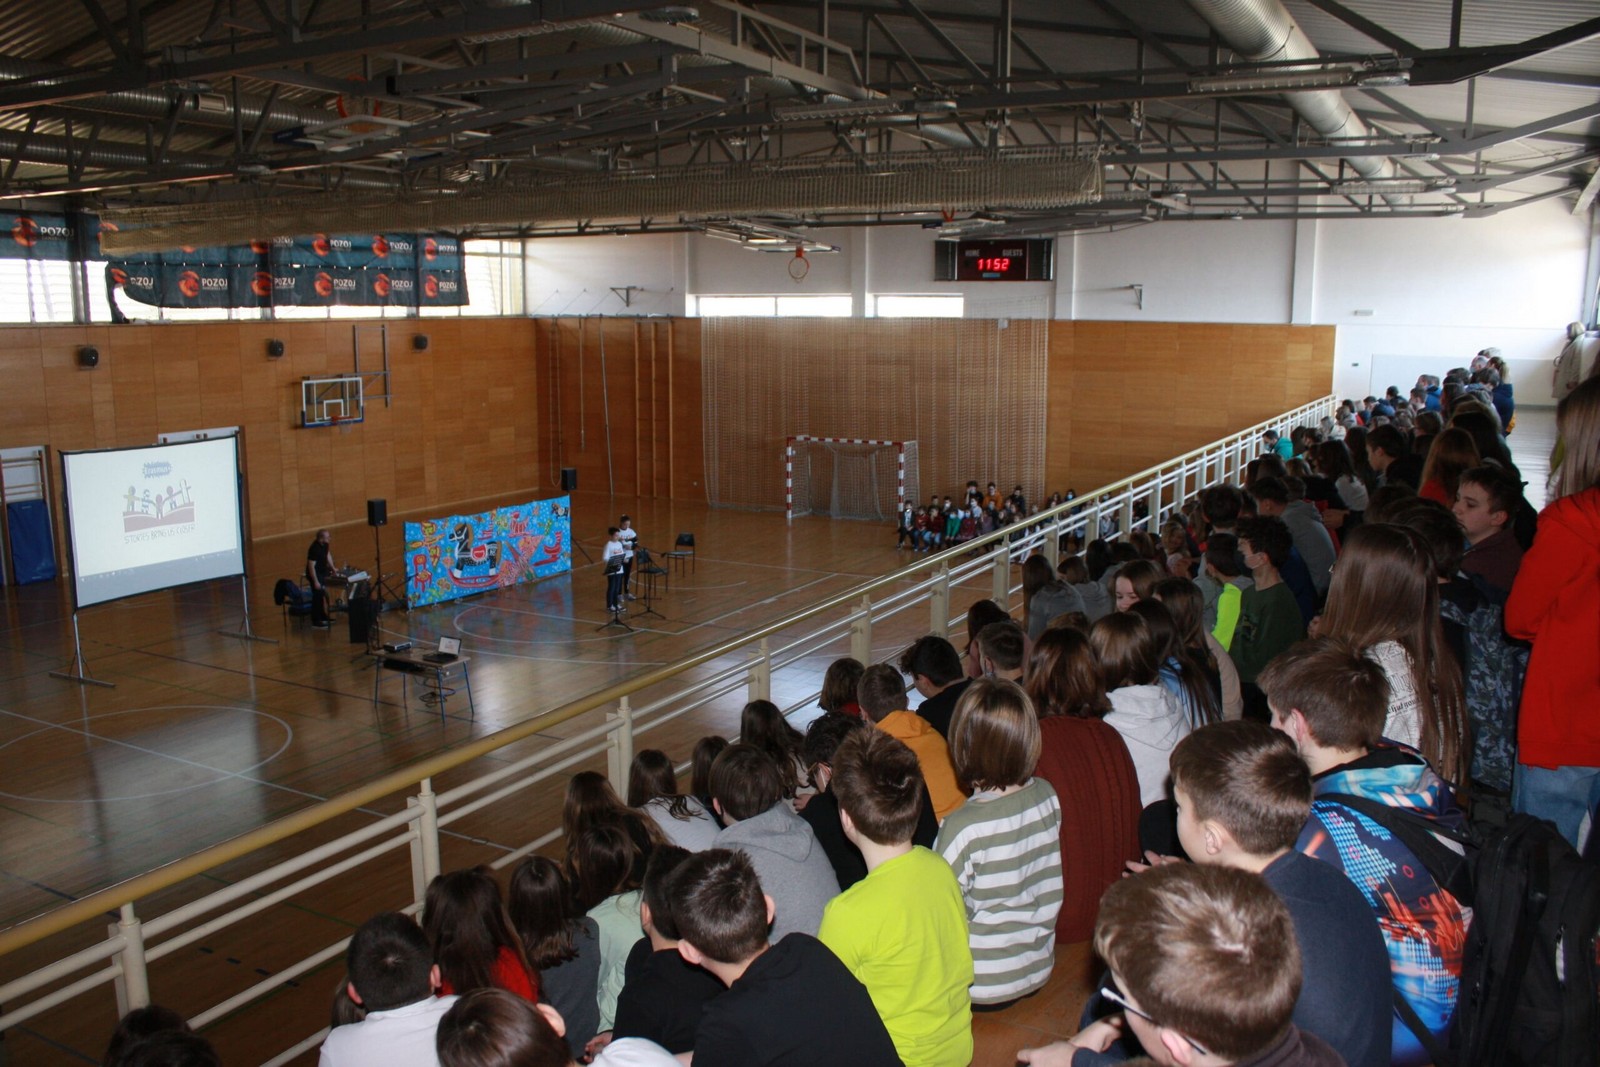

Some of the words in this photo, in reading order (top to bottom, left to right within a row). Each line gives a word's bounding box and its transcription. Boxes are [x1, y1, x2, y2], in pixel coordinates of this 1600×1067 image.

[40, 226, 75, 237] POZOJ
[390, 242, 412, 250] POZOJ
[1002, 249, 1023, 257] GUESTS
[201, 278, 228, 287] POZOJ
[333, 279, 356, 287] POZOJ
[392, 280, 413, 288] POZOJ
[439, 281, 458, 289] POZOJ
